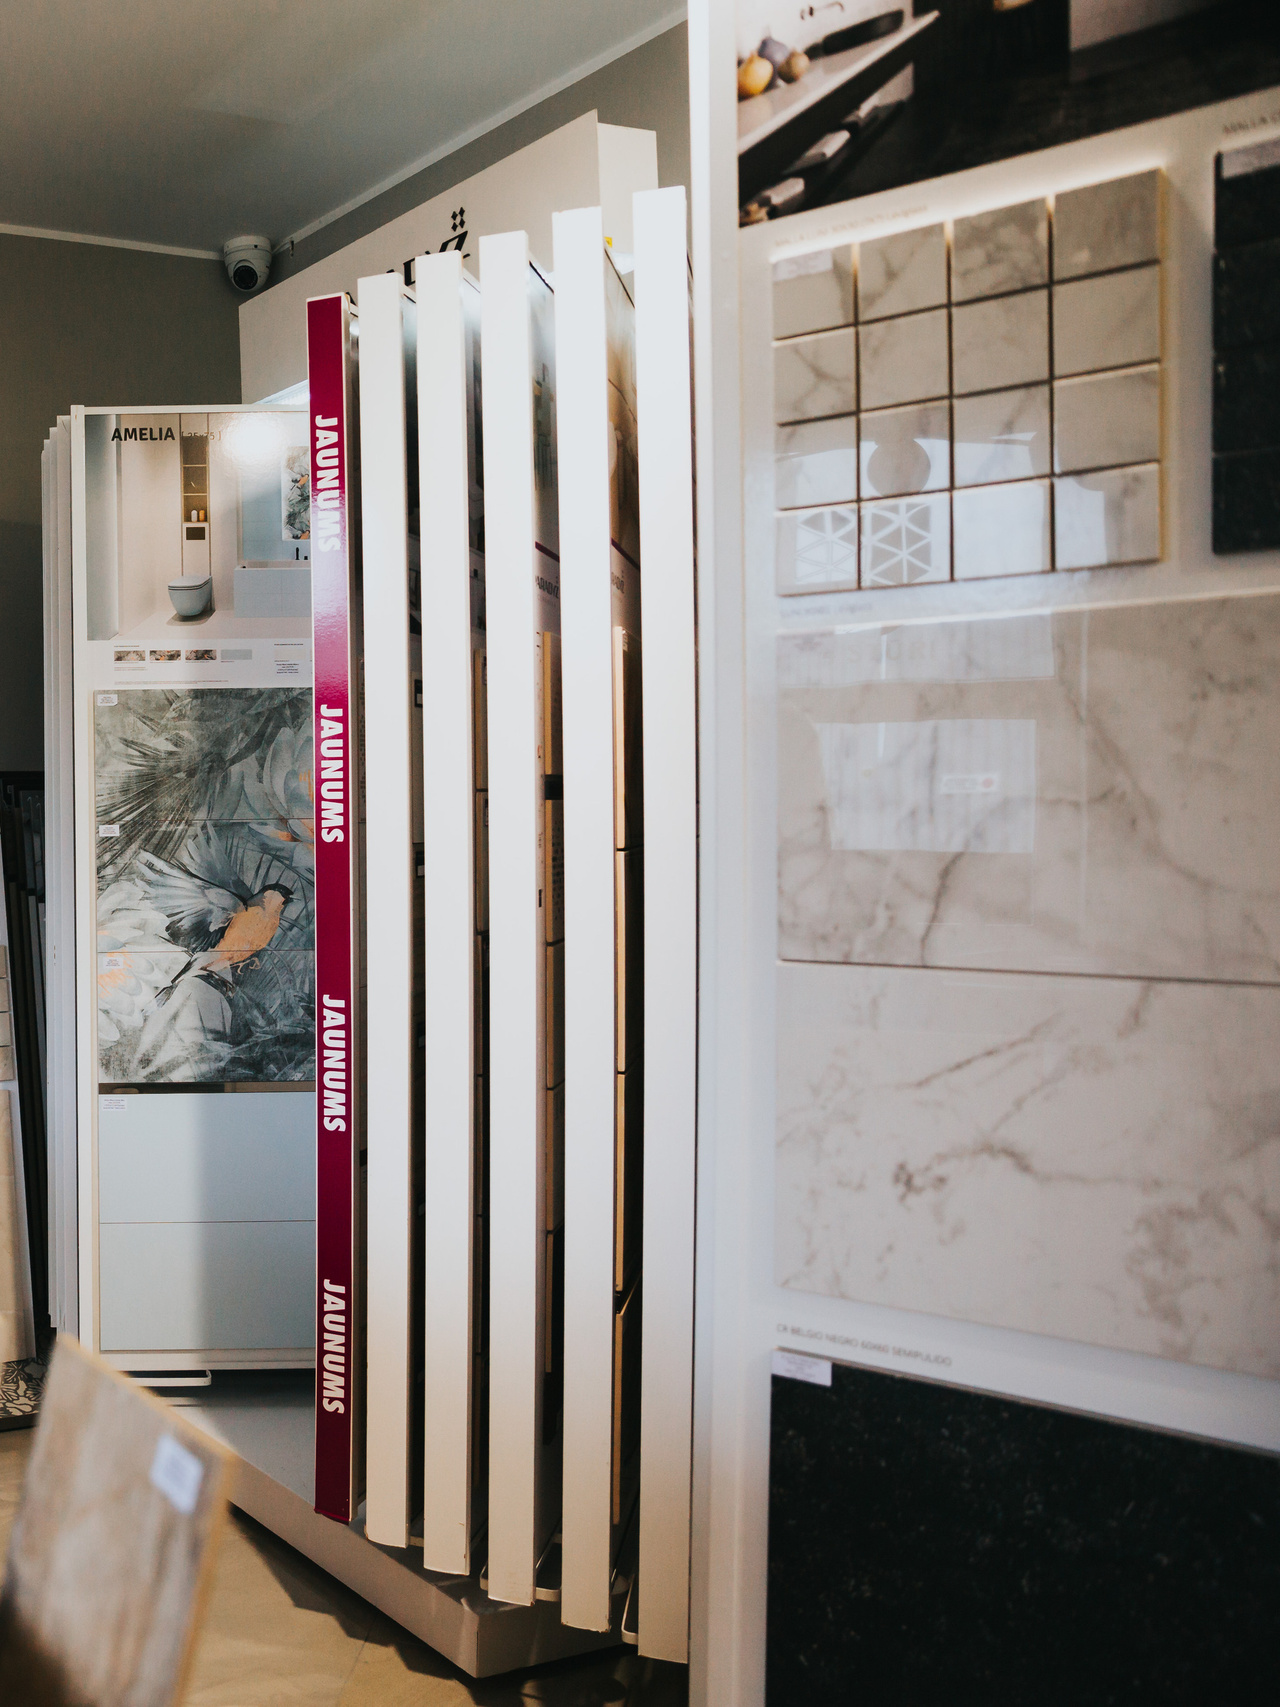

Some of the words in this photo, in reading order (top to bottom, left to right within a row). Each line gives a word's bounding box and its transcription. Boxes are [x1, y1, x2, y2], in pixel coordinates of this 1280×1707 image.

[111, 427, 176, 441] AMELIA
[315, 415, 341, 552] JAUNUMS
[320, 704, 344, 843] JAUNUMS
[322, 994, 347, 1132] JAUNUMS
[322, 1278, 346, 1414] JAUNUMS
